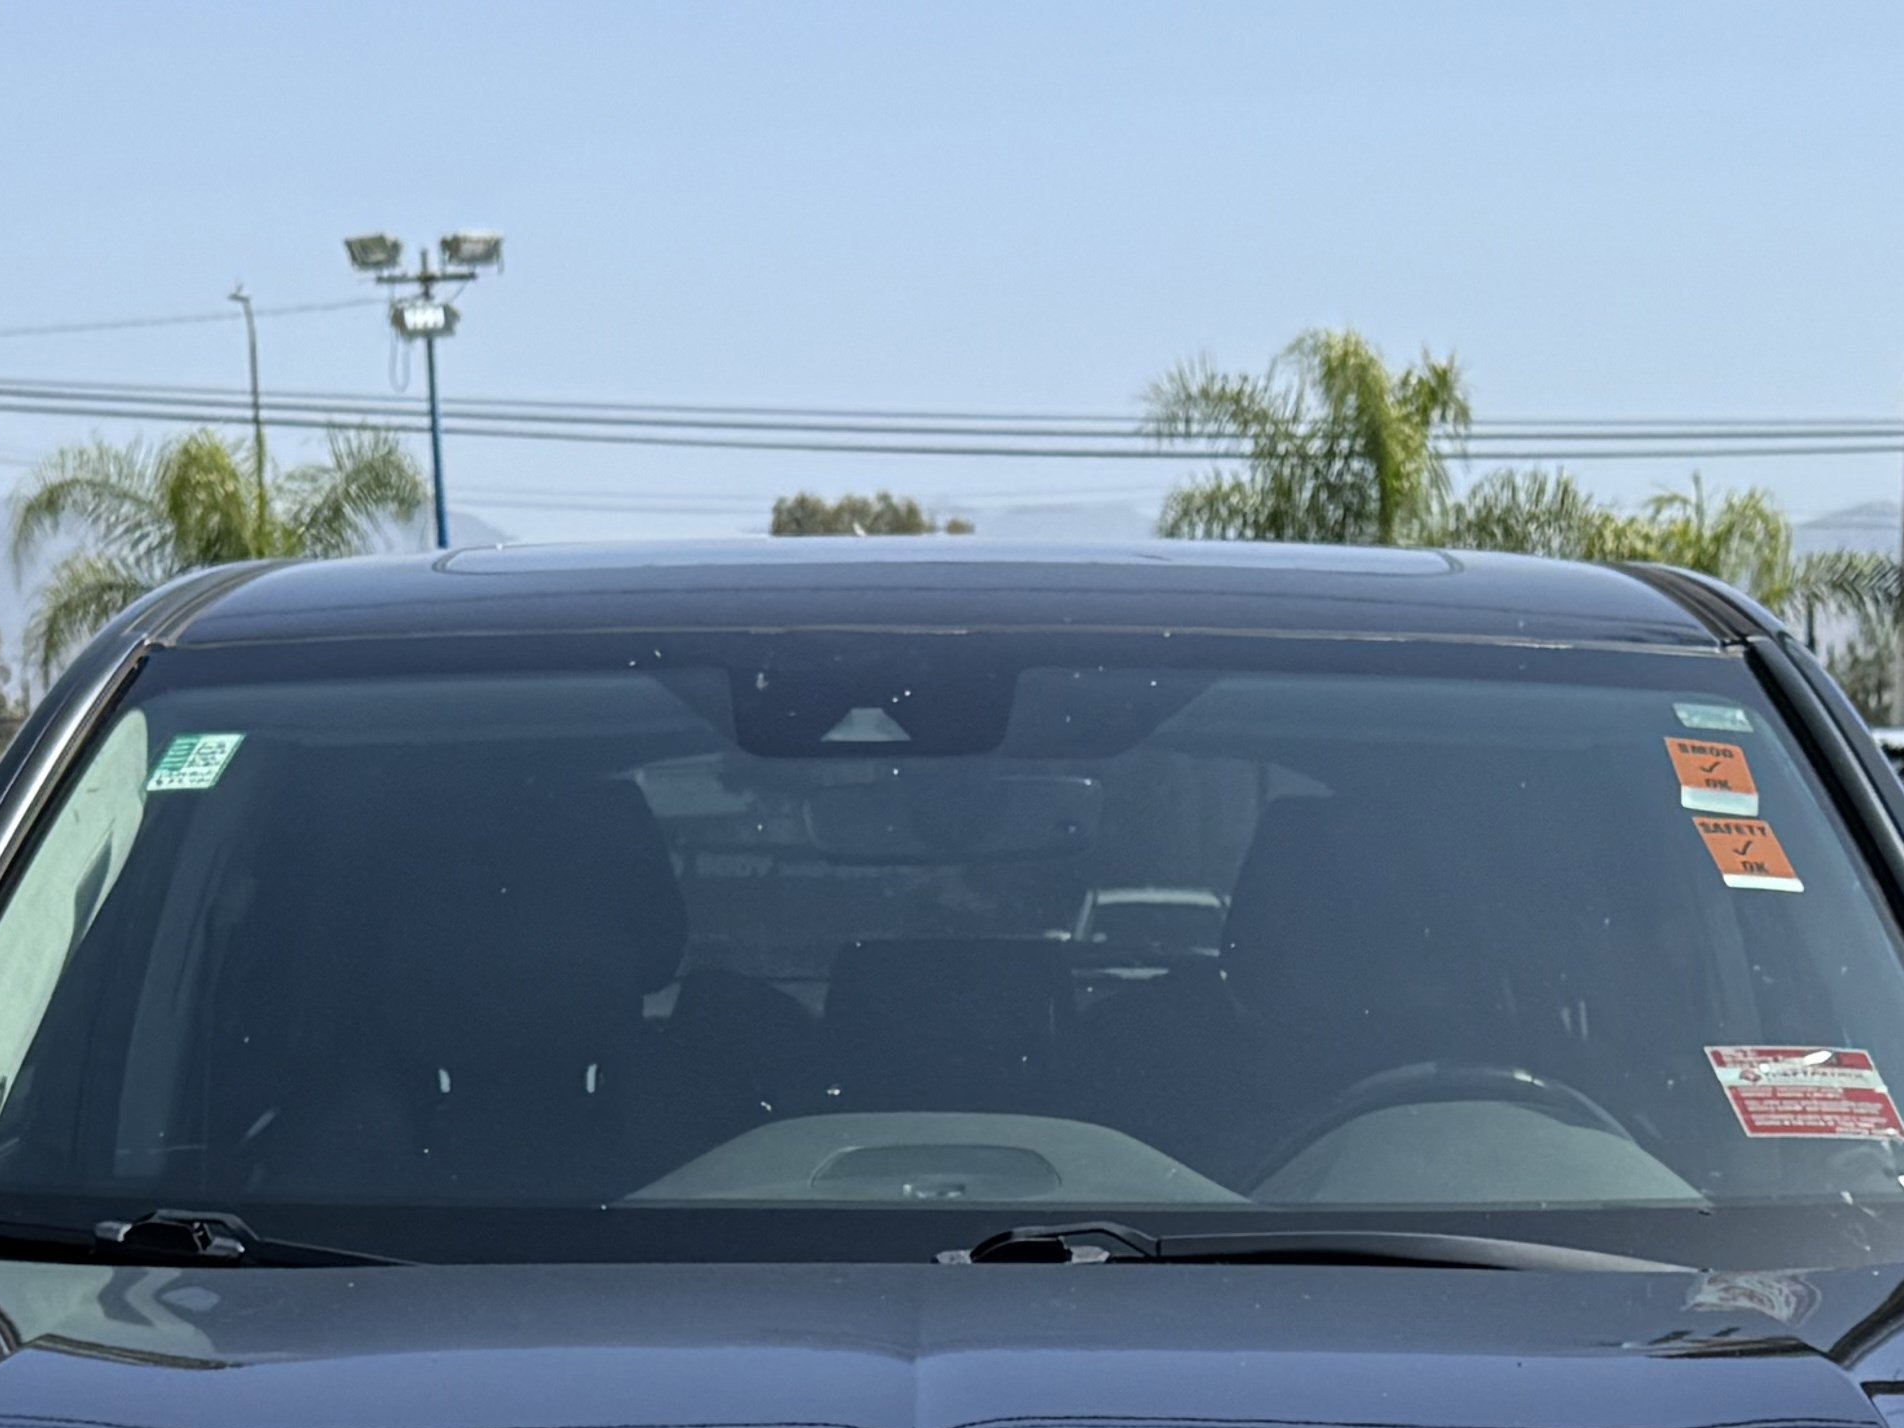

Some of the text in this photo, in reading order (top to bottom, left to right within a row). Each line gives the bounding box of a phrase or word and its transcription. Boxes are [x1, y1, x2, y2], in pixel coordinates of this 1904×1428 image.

[1677, 742, 1735, 760] SMOG
[1705, 777, 1732, 791] OK
[1697, 821, 1769, 837] SAFETY
[1740, 859, 1770, 875] OK
